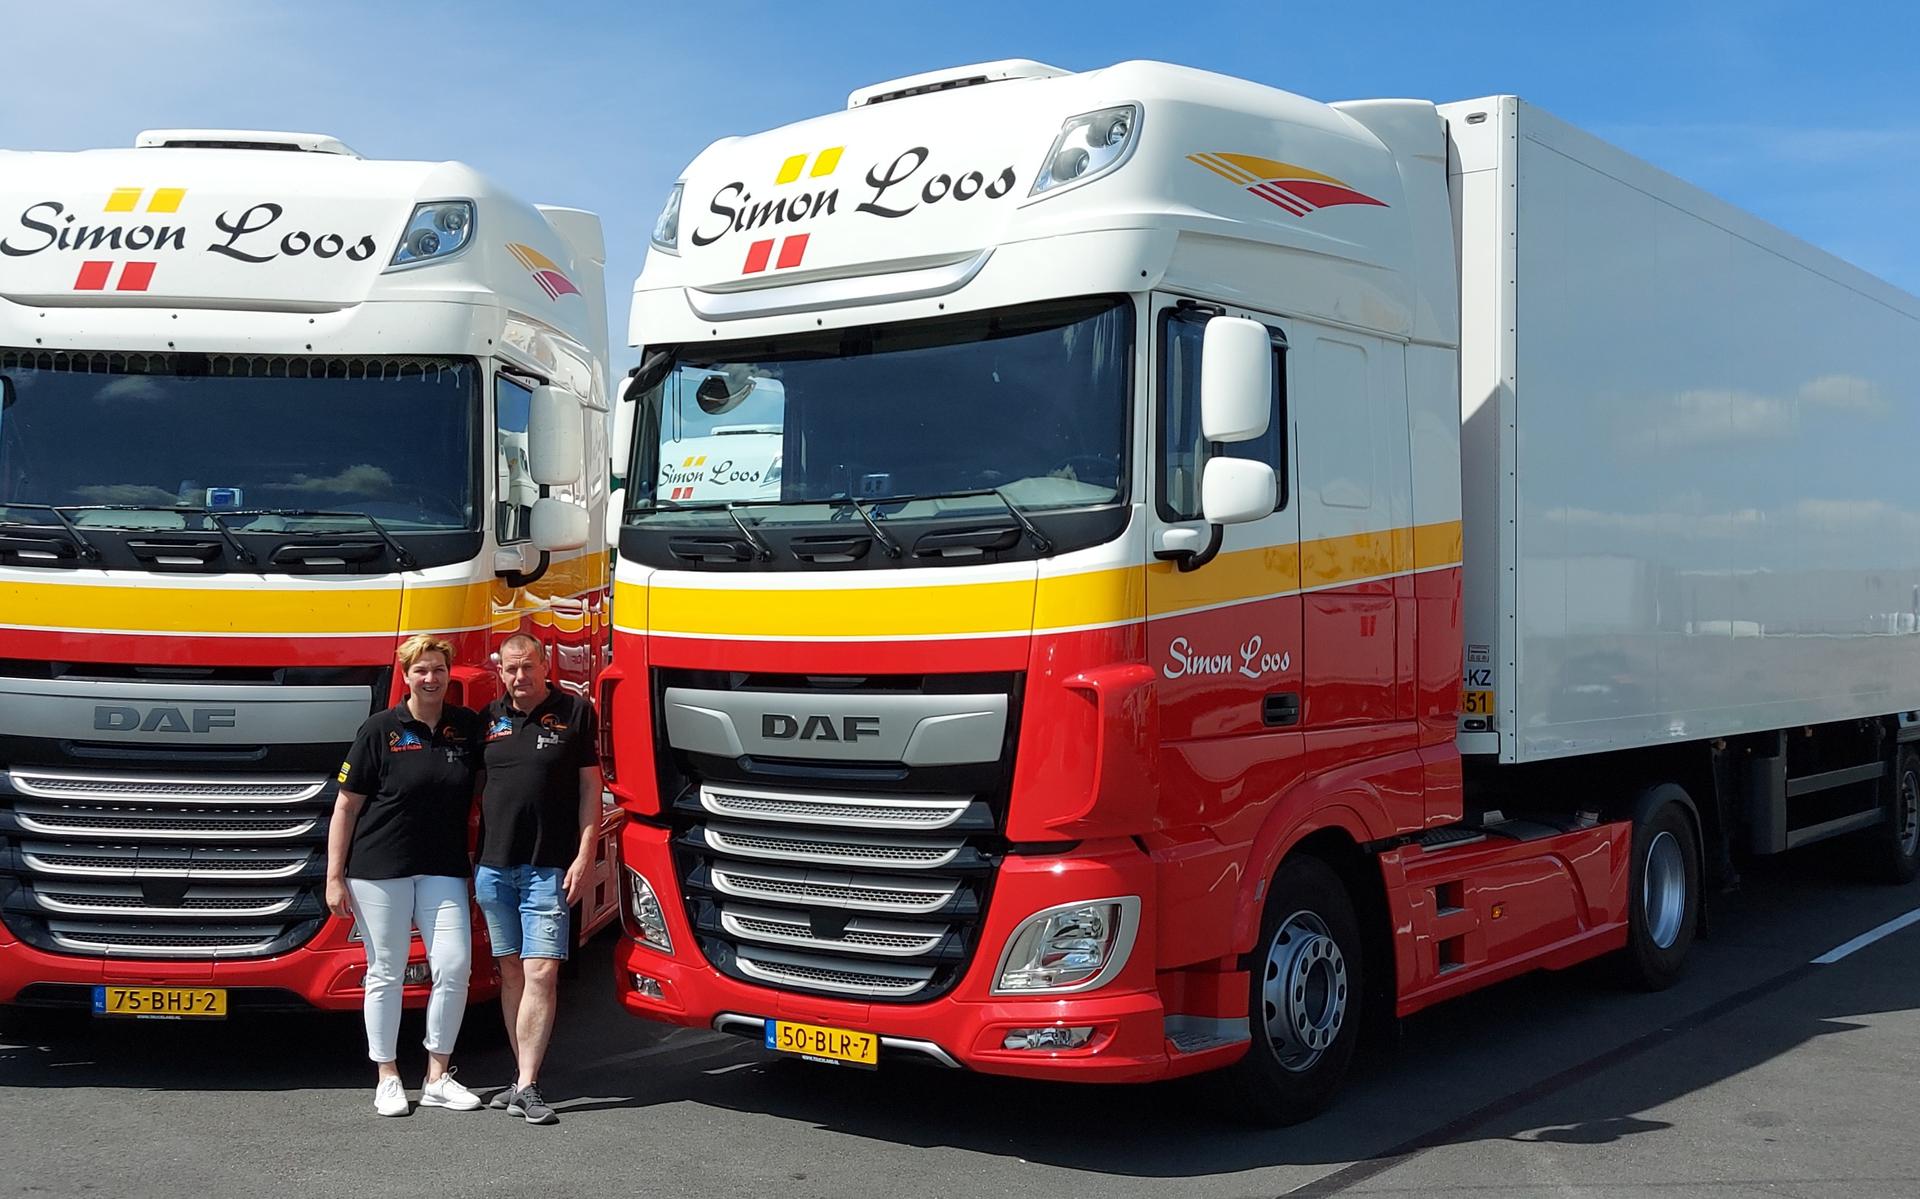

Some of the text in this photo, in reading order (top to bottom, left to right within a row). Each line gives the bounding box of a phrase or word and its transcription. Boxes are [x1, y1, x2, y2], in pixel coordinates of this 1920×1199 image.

[692, 146, 1016, 246] Simon Loos
[1, 201, 376, 263] Simon Loos
[659, 460, 760, 487] Simon Loos
[1163, 634, 1290, 679] Simon Loos
[1461, 692, 1487, 713] 51
[94, 705, 236, 733] DAF
[762, 713, 880, 742] DAF
[114, 990, 217, 1012] 75-BHJ-2
[783, 1026, 870, 1059] 50-BLR-7
